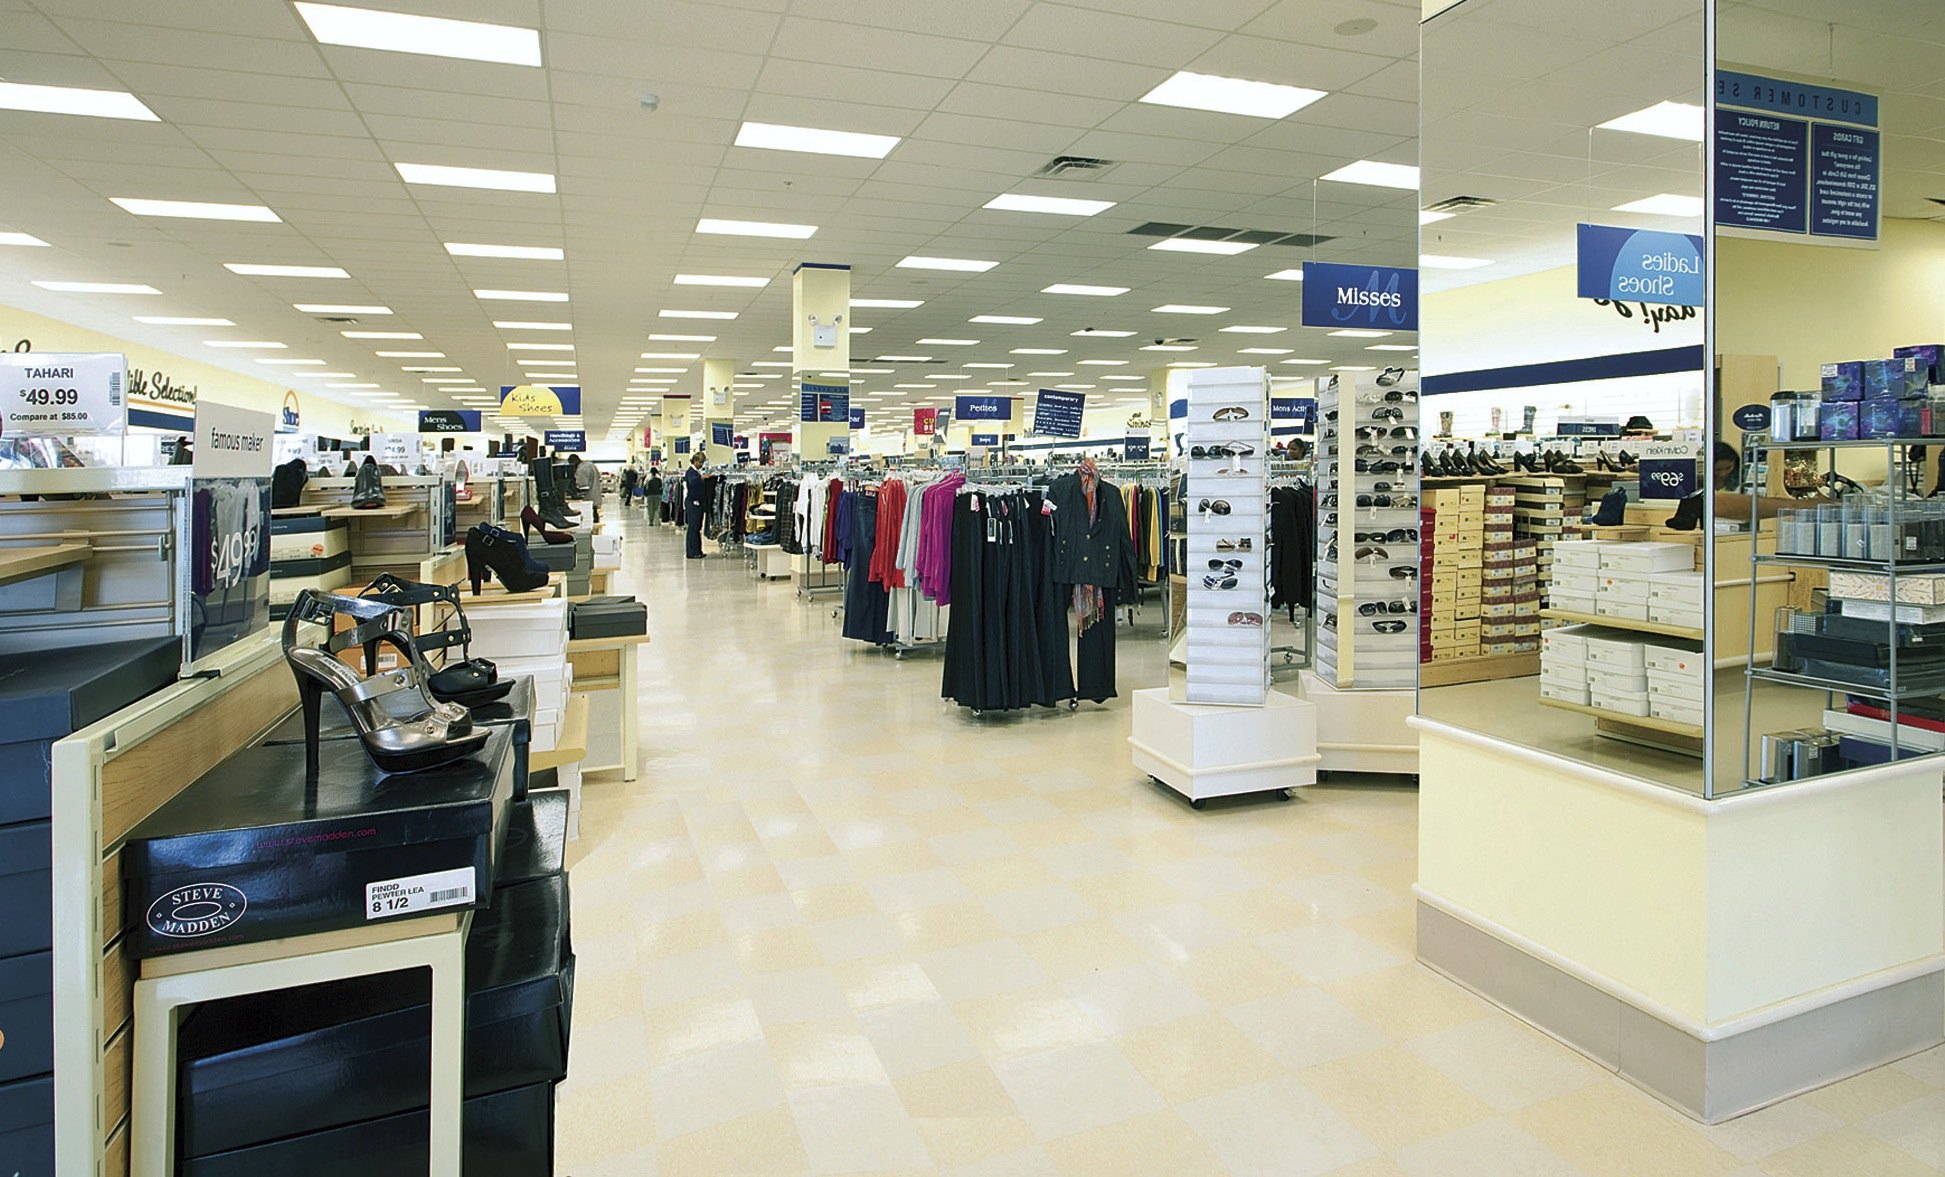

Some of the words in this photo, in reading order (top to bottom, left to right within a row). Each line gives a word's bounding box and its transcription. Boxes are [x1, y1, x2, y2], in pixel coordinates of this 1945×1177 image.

[1336, 287, 1402, 308] Misses
[24, 368, 75, 379] TAHARI
[19, 388, 79, 406] $49.99
[519, 403, 553, 413] Shoes
[1273, 404, 1290, 412] Mens
[10, 412, 48, 423] Compare
[50, 413, 58, 422] at
[61, 411, 88, 422] $85.00
[424, 416, 447, 424] Mens
[436, 423, 464, 431] Shoes
[210, 427, 239, 451] famous
[241, 437, 265, 452] maker
[256, 826, 377, 849] www.stevemadden.com
[372, 882, 400, 894] FINDD
[372, 888, 407, 901] PEWTER
[408, 886, 425, 895] LEA
[171, 886, 223, 906] STEVE
[372, 901, 382, 913] 8
[387, 896, 410, 911] 1/2
[161, 911, 232, 934] MADDEN
